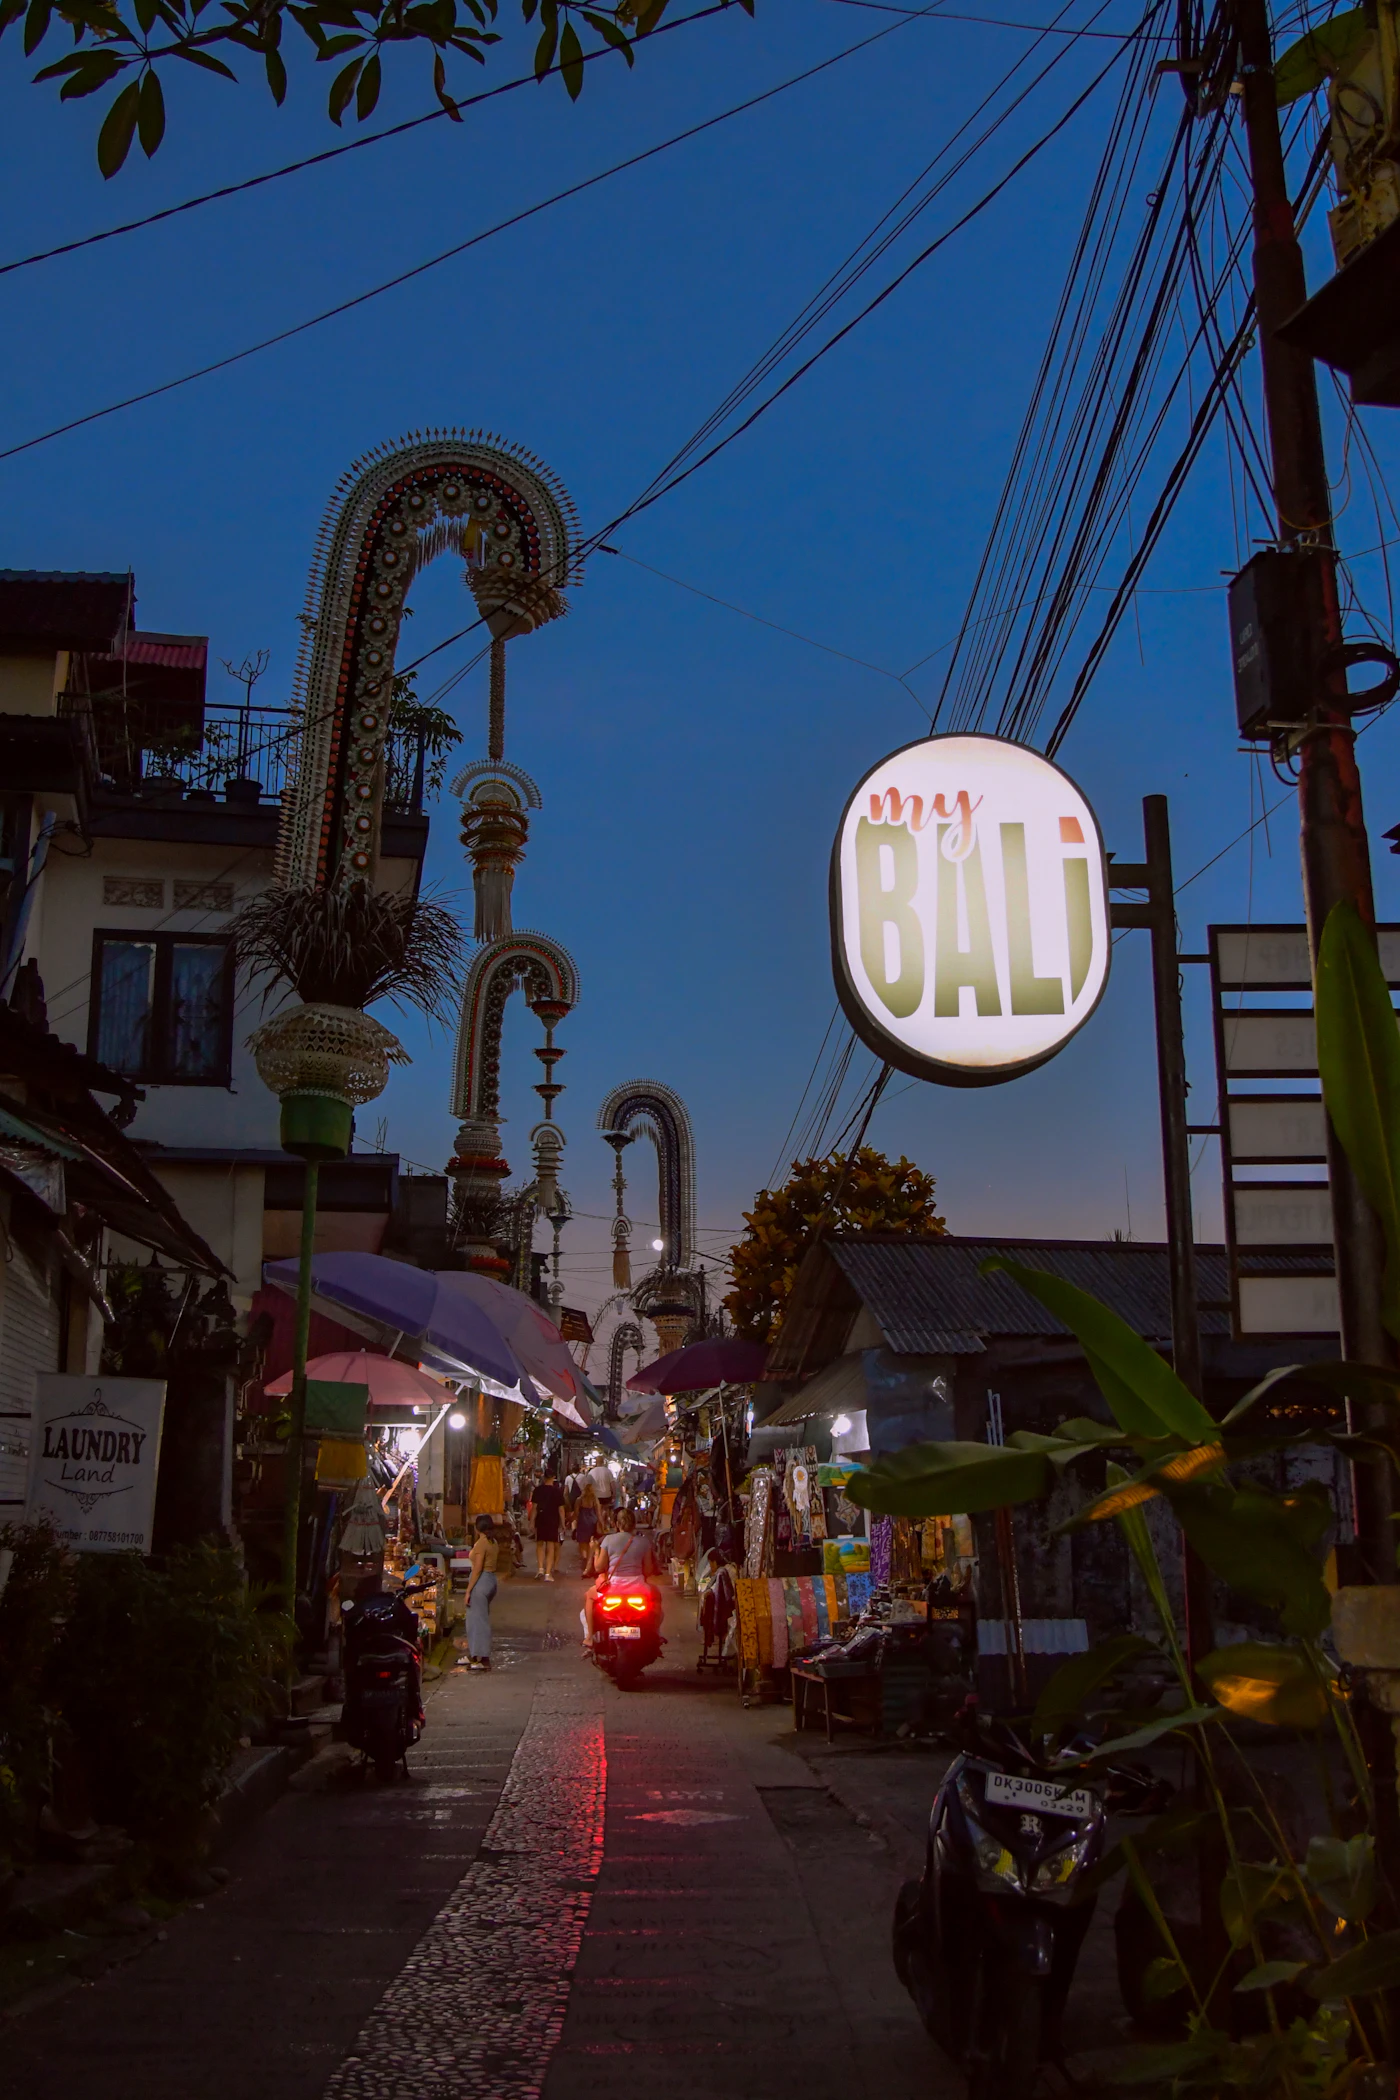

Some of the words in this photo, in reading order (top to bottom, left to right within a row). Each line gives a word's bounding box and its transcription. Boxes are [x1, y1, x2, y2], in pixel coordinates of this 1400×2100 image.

[869, 787, 984, 859] my
[42, 1426, 146, 1464] LAUNDRY
[61, 1463, 115, 1483] Land
